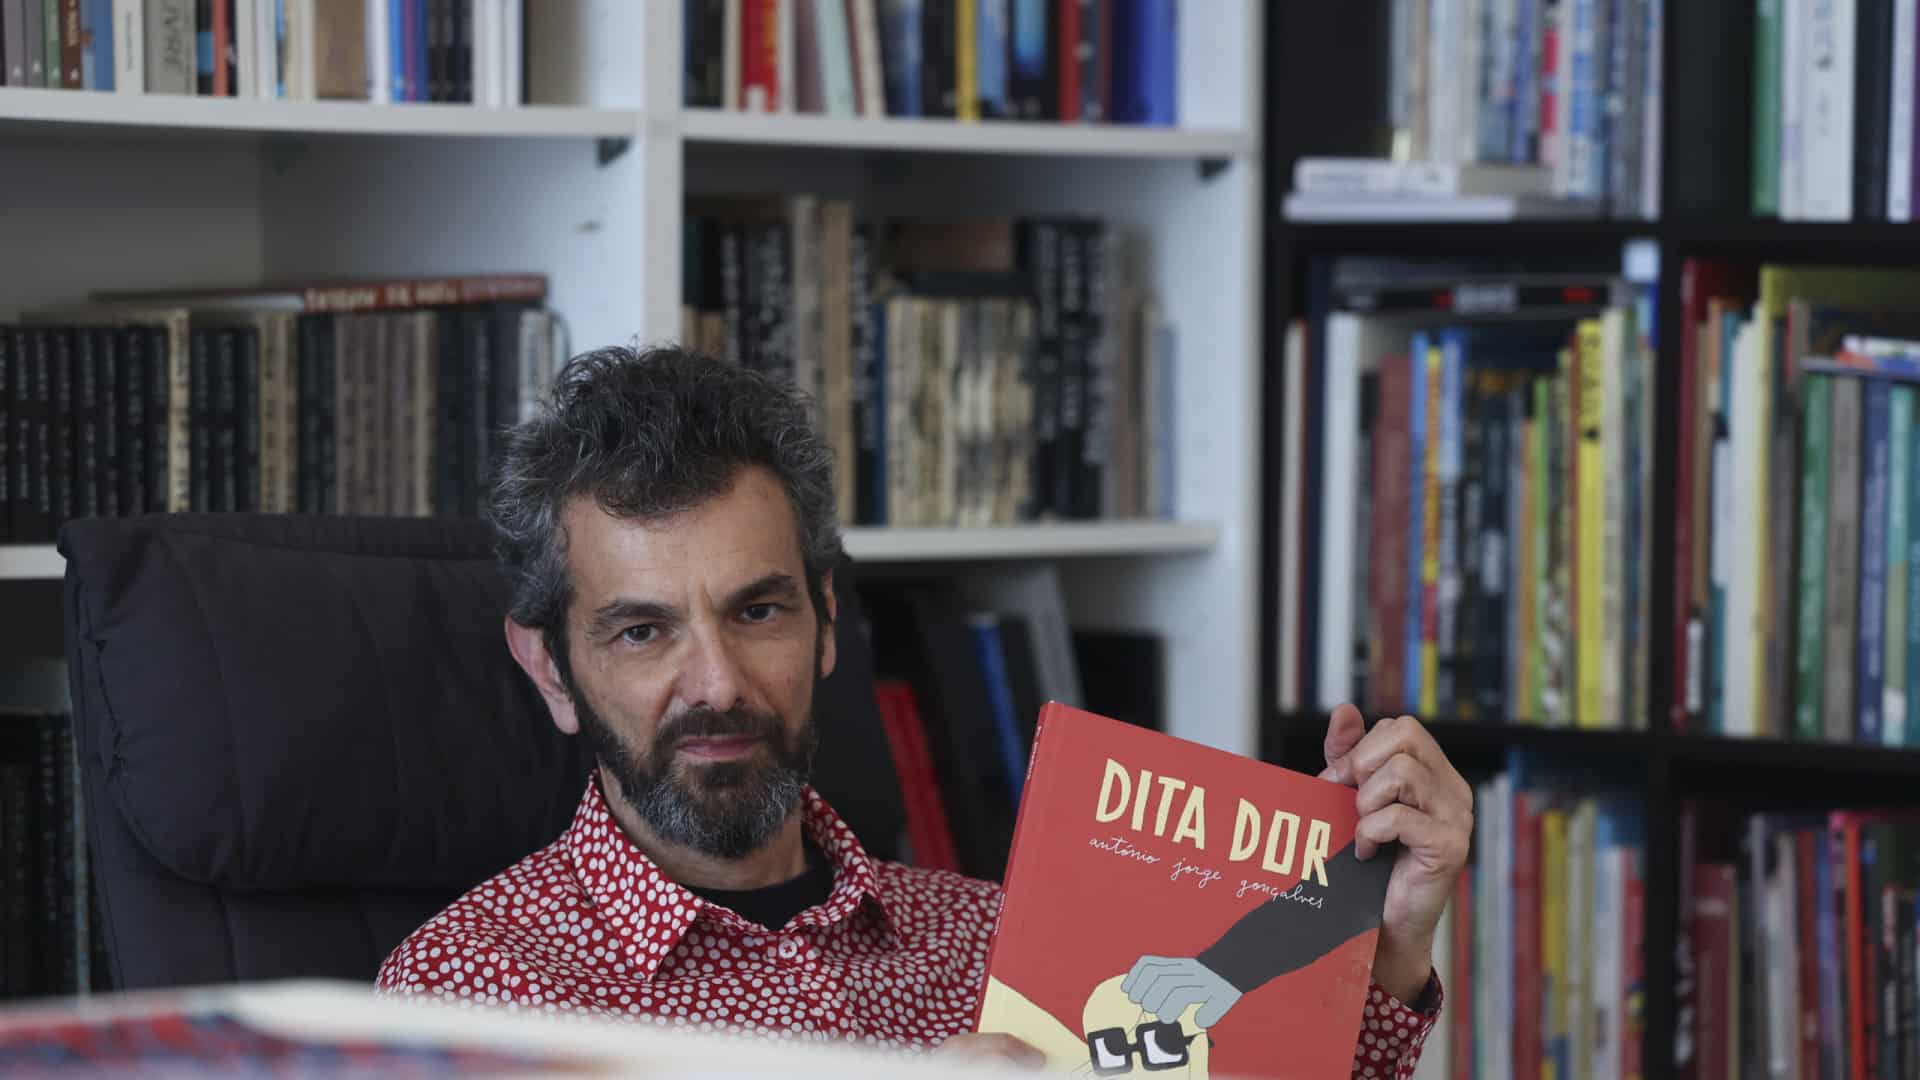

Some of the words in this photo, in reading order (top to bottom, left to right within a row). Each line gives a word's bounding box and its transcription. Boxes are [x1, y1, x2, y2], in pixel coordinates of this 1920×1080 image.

[1096, 758, 1205, 850] DITA
[1229, 798, 1331, 887] DOR
[1089, 837, 1160, 864] antónio
[1170, 857, 1222, 888] jorge
[1236, 879, 1324, 909] gonçalves
